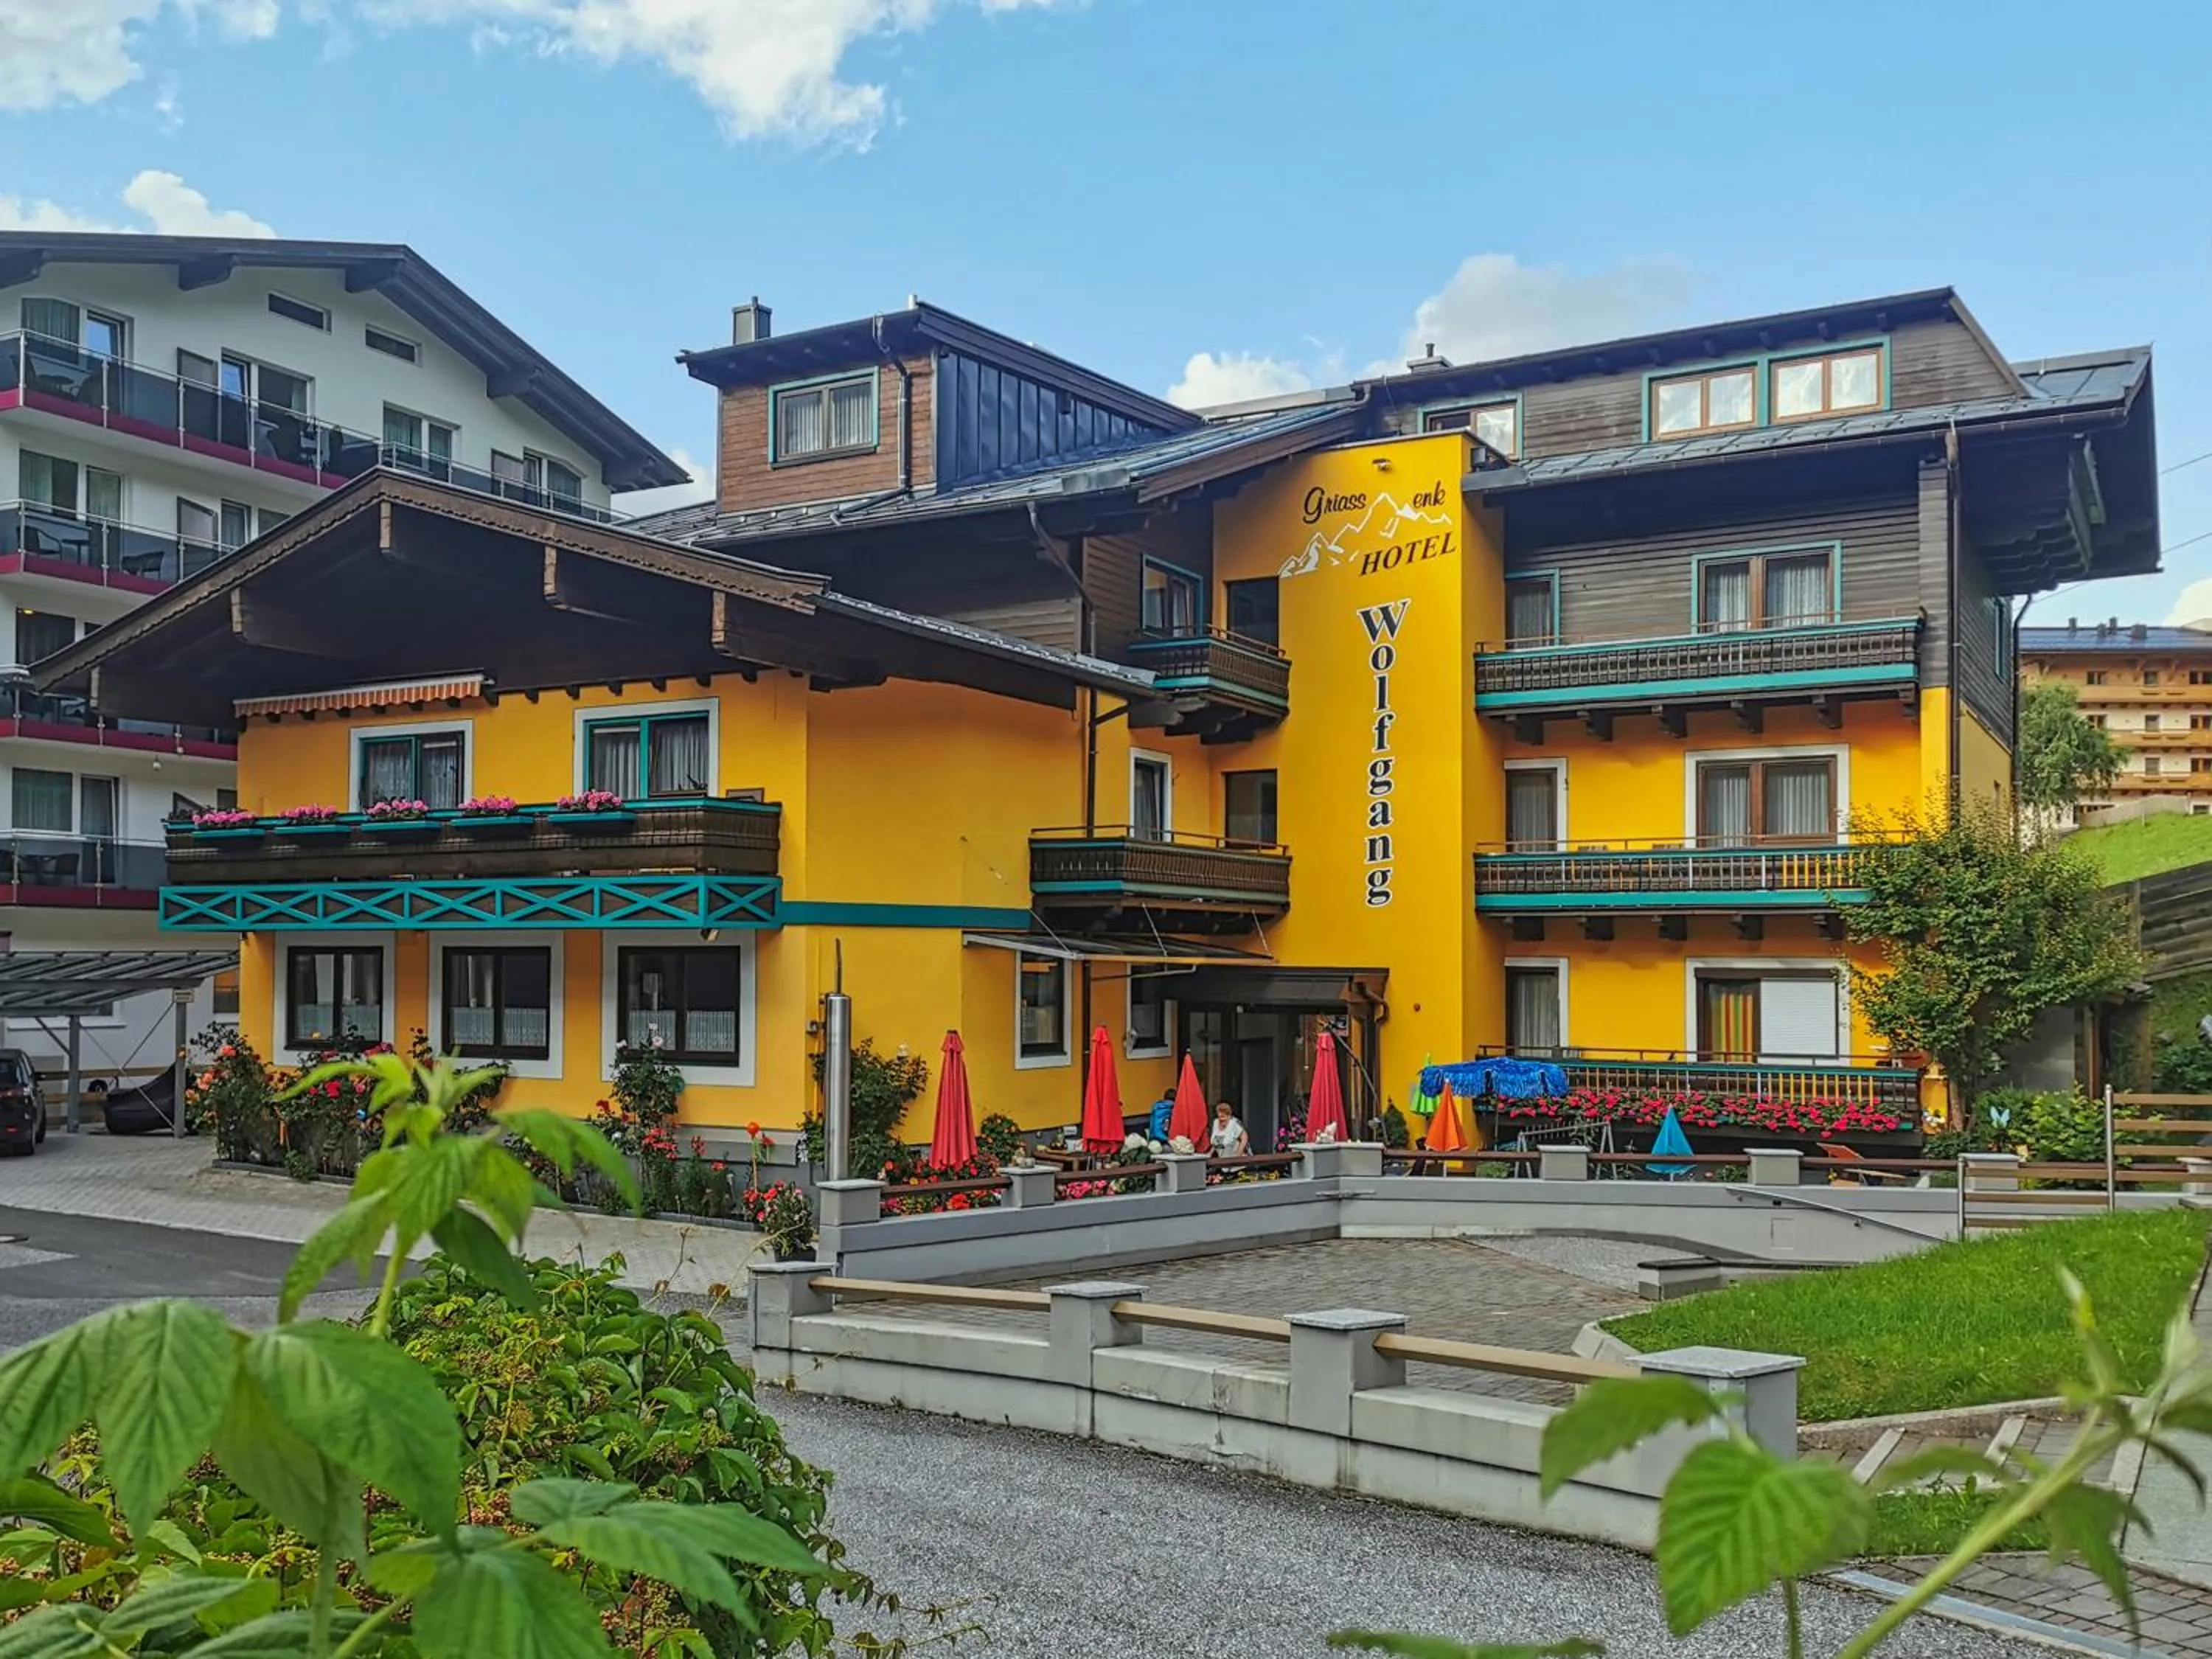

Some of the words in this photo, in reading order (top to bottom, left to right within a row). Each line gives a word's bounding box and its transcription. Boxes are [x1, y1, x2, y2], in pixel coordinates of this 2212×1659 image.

[1303, 486, 1366, 524] Griass
[1413, 481, 1446, 507] enk
[1360, 532, 1456, 577] HOTEL
[1357, 598, 1412, 906] Wolfgang
